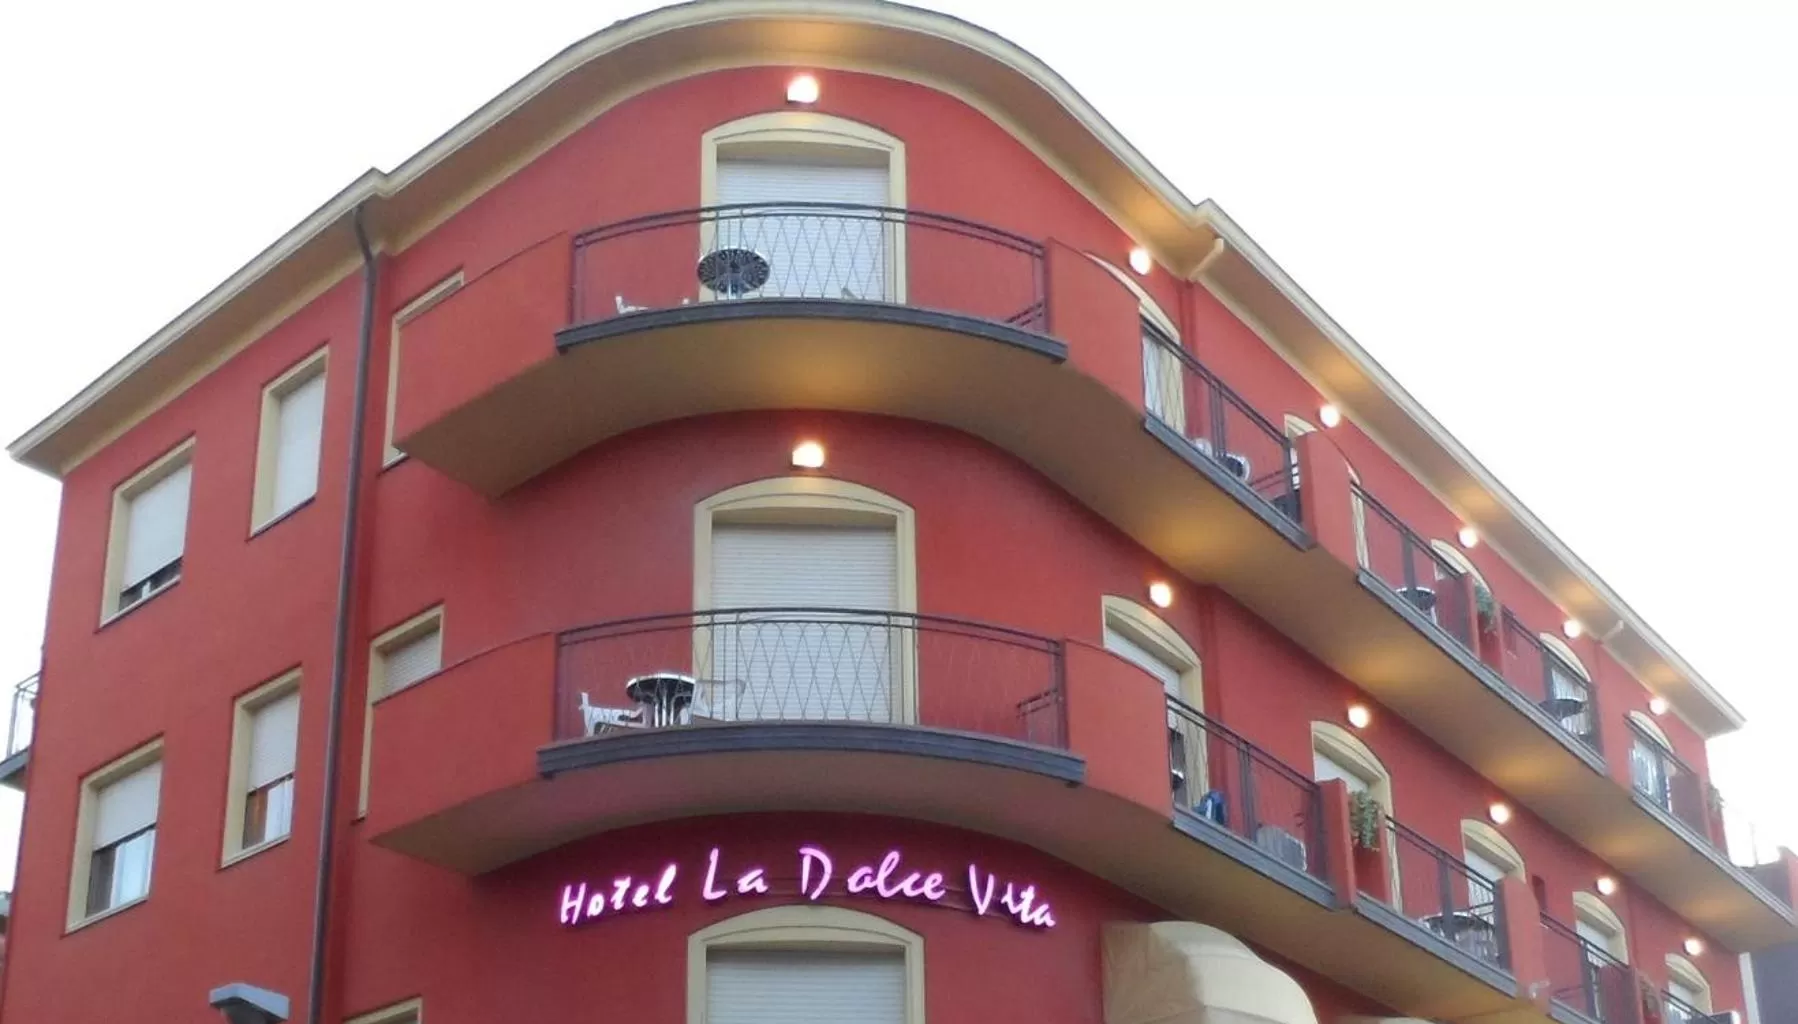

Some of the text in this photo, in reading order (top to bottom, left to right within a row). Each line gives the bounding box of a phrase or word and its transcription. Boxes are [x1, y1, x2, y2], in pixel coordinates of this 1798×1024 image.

[559, 846, 1057, 928] Hotel La Dolce Vita
